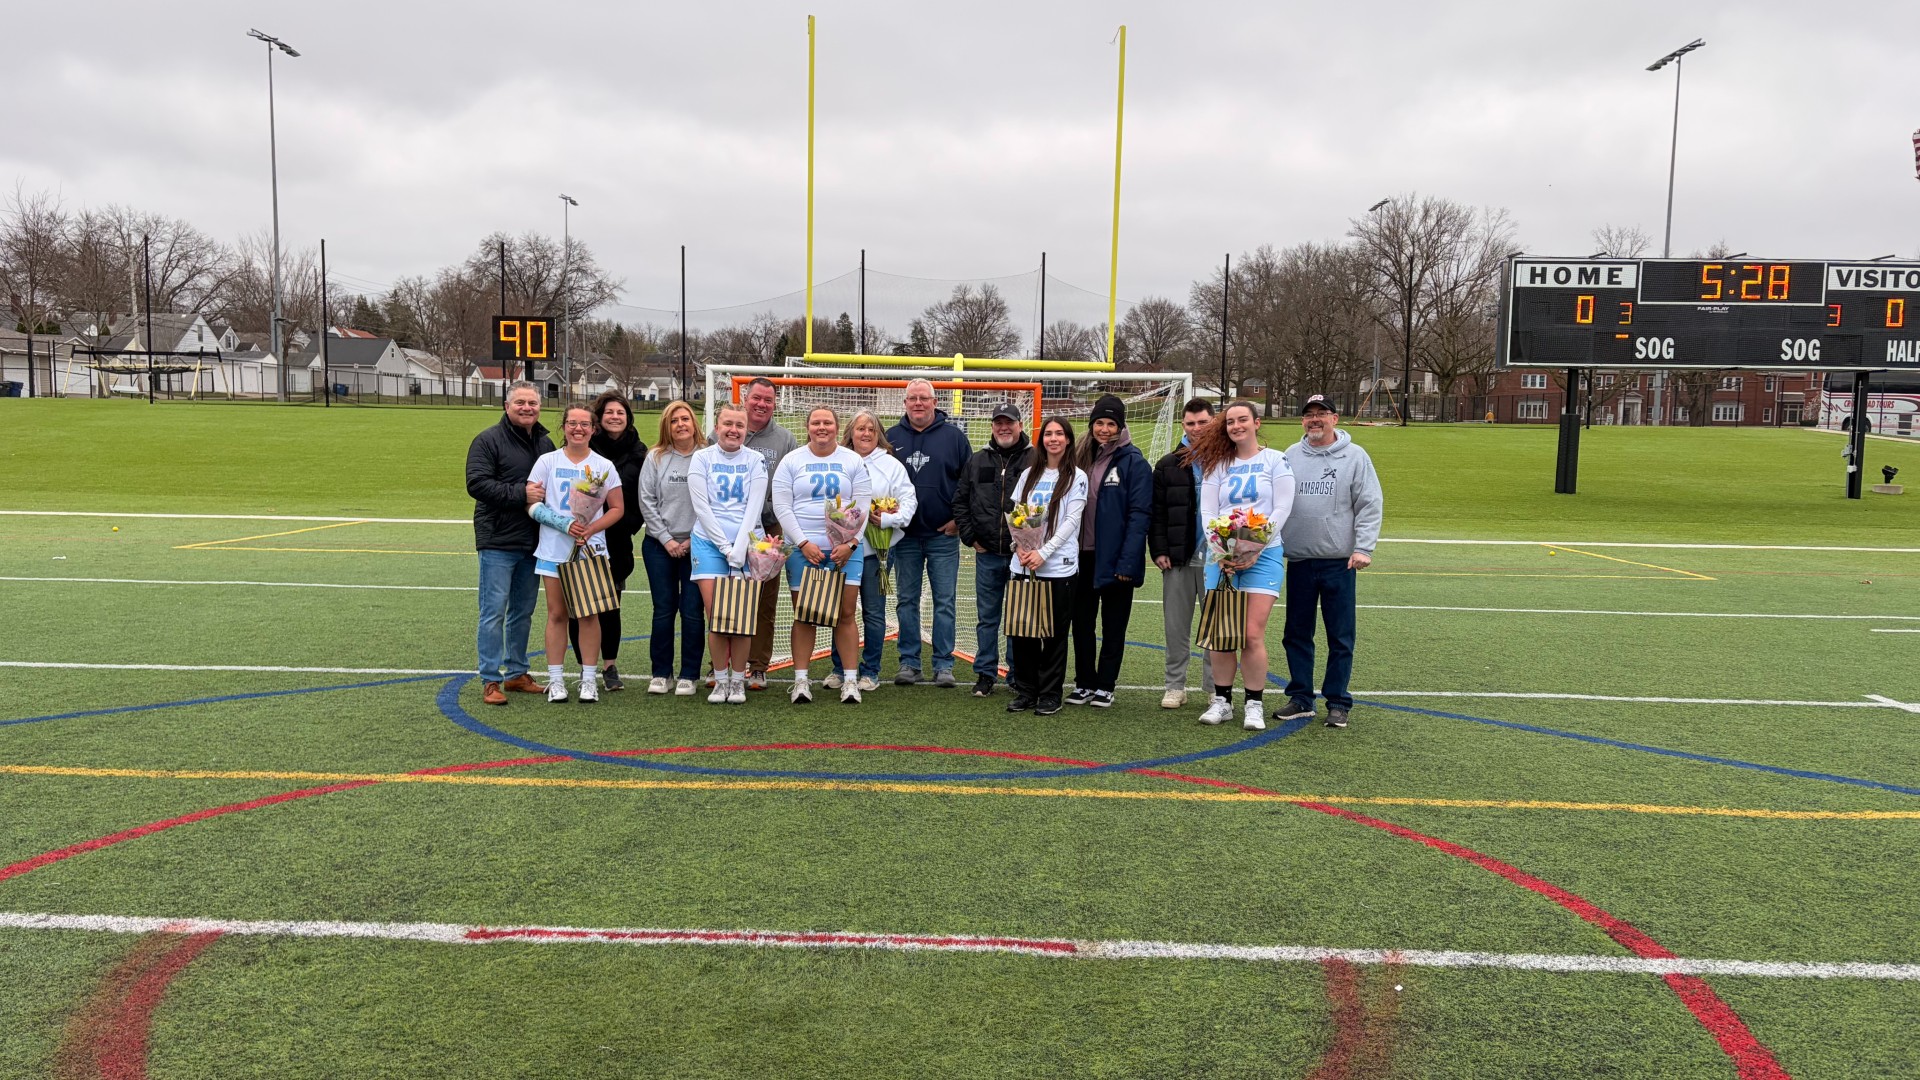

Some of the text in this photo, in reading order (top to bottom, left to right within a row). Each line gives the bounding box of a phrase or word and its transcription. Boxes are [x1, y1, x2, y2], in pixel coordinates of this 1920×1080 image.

[1529, 266, 1623, 286] HOME
[1701, 265, 1790, 300] 5:28
[1576, 295, 1595, 324] 0
[1618, 302, 1633, 325] 3
[1826, 304, 1842, 327] 3
[1885, 298, 1905, 328] 0
[499, 320, 547, 358] 90
[1634, 336, 1675, 360] SOG
[1780, 338, 1821, 361] SOG
[716, 474, 745, 503] 34
[809, 473, 840, 500] 28
[1228, 475, 1258, 504] 24
[1299, 481, 1334, 495] AMBROSE
